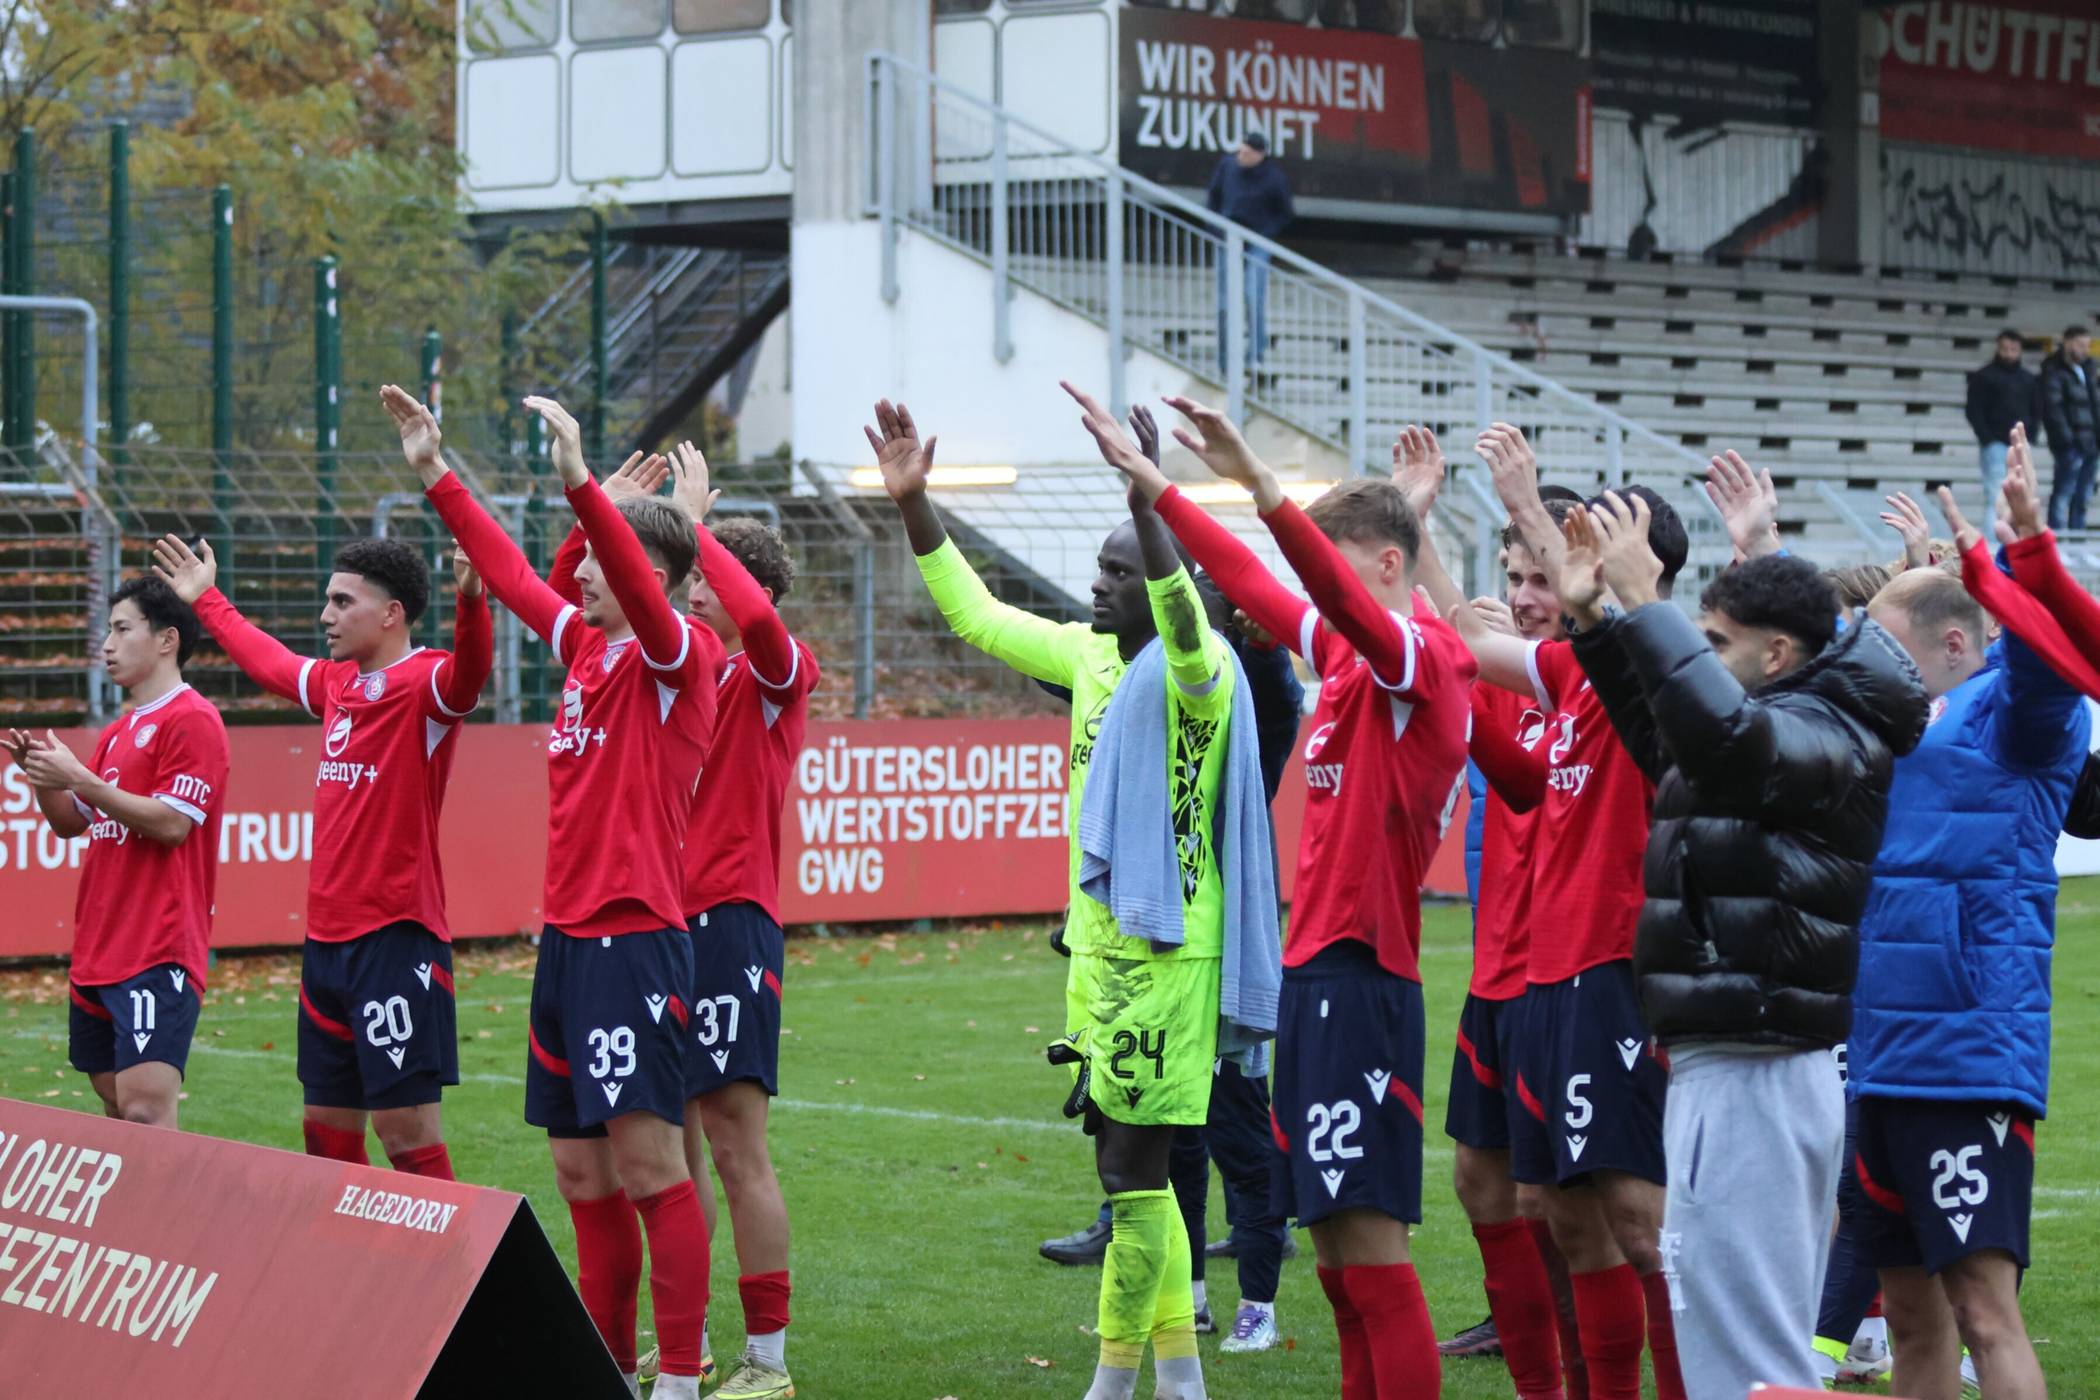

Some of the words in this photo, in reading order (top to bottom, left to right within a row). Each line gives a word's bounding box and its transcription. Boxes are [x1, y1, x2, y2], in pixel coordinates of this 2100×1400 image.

[1136, 39, 1216, 96] WIR
[1226, 39, 1386, 112] KÖNNEN
[1137, 95, 1320, 160] ZUKUNFT
[798, 736, 1065, 794] GÜTERSLOHER
[798, 847, 884, 896] GWG
[129, 989, 156, 1030] 11
[363, 995, 413, 1047] 20
[696, 994, 741, 1046] 37
[588, 1026, 637, 1079] 39
[1110, 1029, 1166, 1080] 24
[1566, 1073, 1593, 1128] 5
[1307, 1099, 1364, 1162] 22
[1929, 1144, 1989, 1209] 25
[334, 1184, 458, 1234] HAGEDORN
